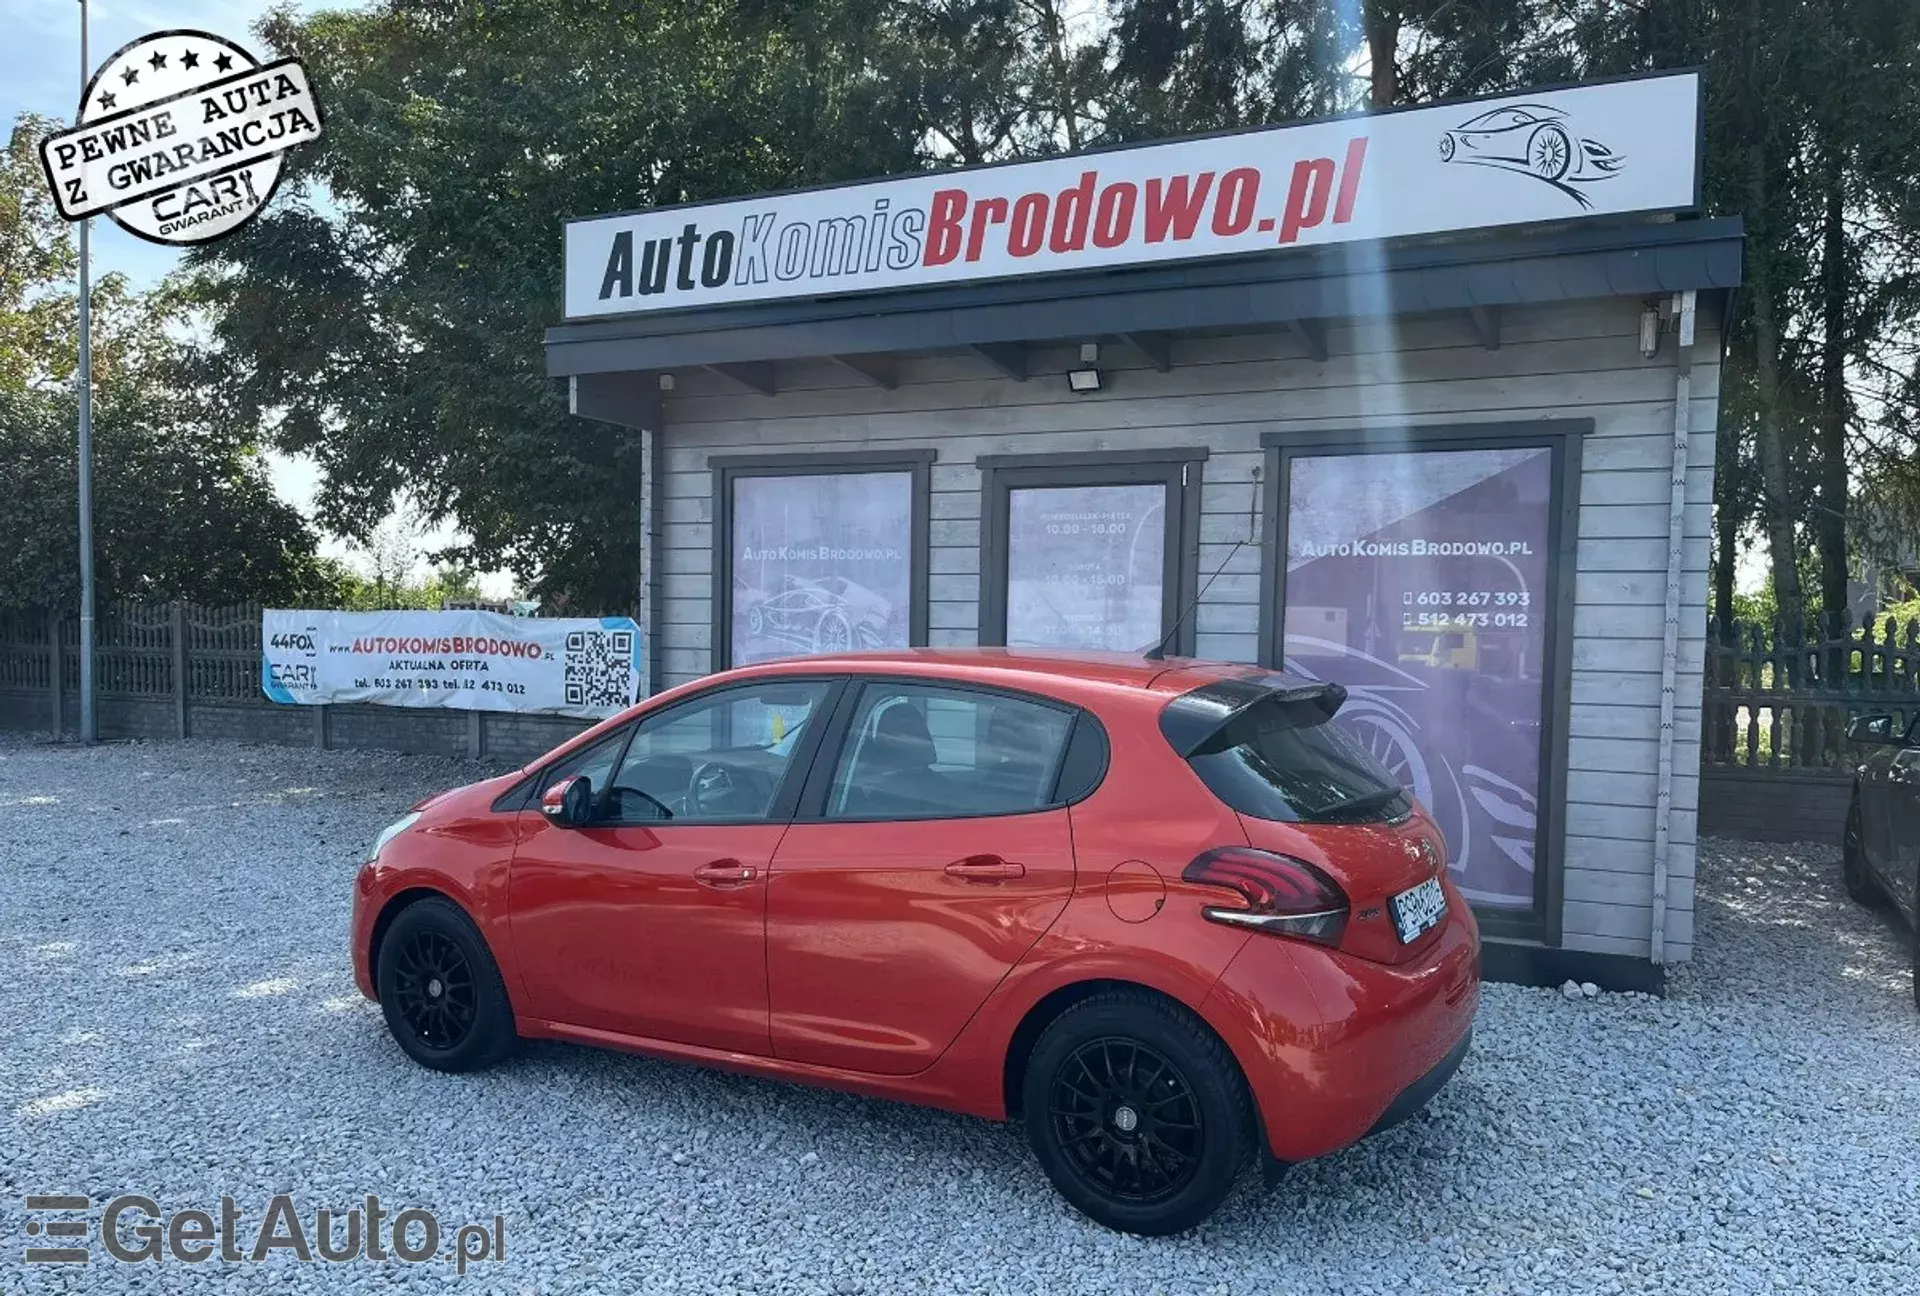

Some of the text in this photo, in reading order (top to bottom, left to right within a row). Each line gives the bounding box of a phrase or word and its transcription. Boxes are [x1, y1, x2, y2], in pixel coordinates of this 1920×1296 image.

[599, 137, 1369, 300] AutoKomisBrodowo.pl
[1417, 591, 1530, 605] 603 267 393
[1418, 613, 1528, 627] 512 473 012
[389, 660, 446, 671] AKTUALNA
[355, 677, 371, 688] tel.
[374, 678, 391, 689] 603
[395, 678, 413, 689] 267
[418, 679, 439, 690] 393
[443, 679, 460, 690] tel.
[481, 680, 503, 692] 473
[507, 683, 526, 695] 012
